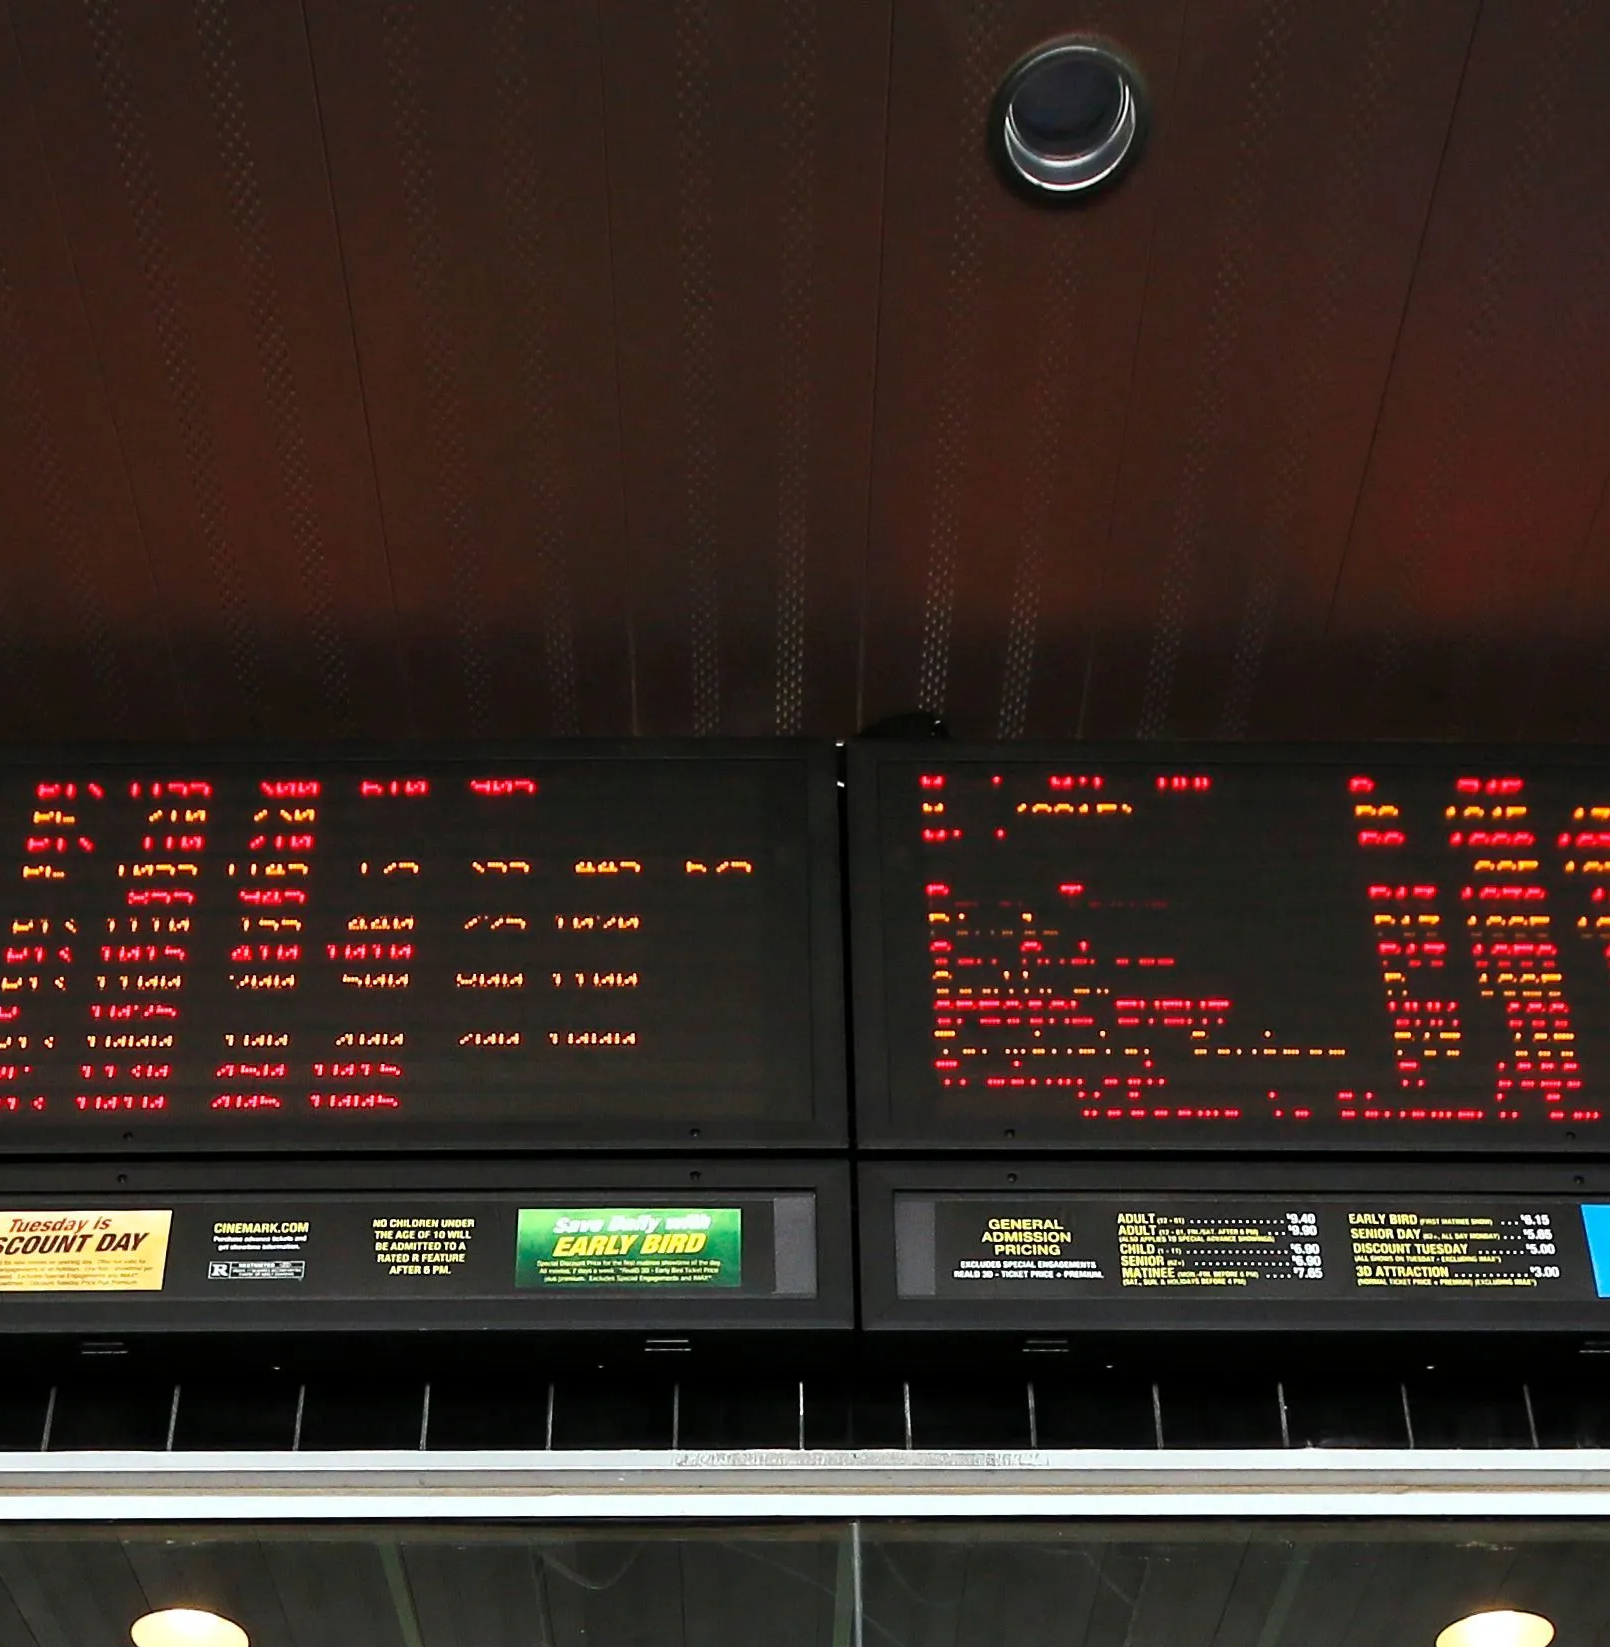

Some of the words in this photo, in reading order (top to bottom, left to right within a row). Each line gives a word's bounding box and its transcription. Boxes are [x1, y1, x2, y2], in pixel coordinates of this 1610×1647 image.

[373, 1220, 387, 1228] NO
[389, 1219, 439, 1228] CHILDREN
[441, 1219, 475, 1228] UNDER
[553, 1217, 604, 1233] Save
[607, 1215, 662, 1233] Daily
[665, 1214, 711, 1230] with
[1117, 1213, 1155, 1224] ADULT
[1286, 1213, 1316, 1224] $9.40
[1349, 1214, 1385, 1225] EARLY
[1389, 1214, 1417, 1225] BIRD
[9, 1218, 88, 1233] Tuesday
[93, 1217, 112, 1230] is
[214, 1222, 309, 1234] CINEMARK.COM
[988, 1219, 1063, 1230] GENERAL
[375, 1230, 393, 1239] THE
[395, 1230, 416, 1239] AGE
[417, 1230, 432, 1239] OF
[433, 1230, 446, 1239] 10
[447, 1230, 471, 1239] WILL
[1118, 1225, 1156, 1236] ADULT
[1288, 1225, 1317, 1236] $9.90
[1350, 1228, 1395, 1240] SENIOR
[1397, 1228, 1421, 1240] DAY
[95, 1233, 148, 1252] DAY
[981, 1232, 1071, 1242] ADMISSION
[375, 1242, 388, 1251] BE
[390, 1242, 441, 1251] ADMITTED
[444, 1242, 457, 1250] TO
[458, 1242, 466, 1250] A
[552, 1235, 640, 1257] EARLY
[640, 1233, 708, 1254] BIRD
[995, 1244, 1061, 1255] PRICING
[1120, 1244, 1155, 1255] CHILD
[1290, 1244, 1320, 1255] $6.90
[1353, 1243, 1410, 1254] DISCOUNT
[1414, 1243, 1468, 1254] TUESDAY
[1526, 1243, 1555, 1255] $5.00
[377, 1253, 409, 1263] RATED
[411, 1253, 420, 1262] R
[421, 1253, 465, 1262] FEATURE
[1121, 1256, 1164, 1267] SENIOR
[1292, 1256, 1321, 1267] $6.90
[211, 1264, 228, 1276] R
[389, 1265, 421, 1275] AFTER
[432, 1265, 451, 1275] PM.
[1002, 1270, 1029, 1278] TICKET
[1122, 1268, 1175, 1279] MATINEE
[1356, 1266, 1372, 1278] 3D
[1376, 1266, 1449, 1277] ATTRACTION
[1530, 1266, 1560, 1278] $3.00
